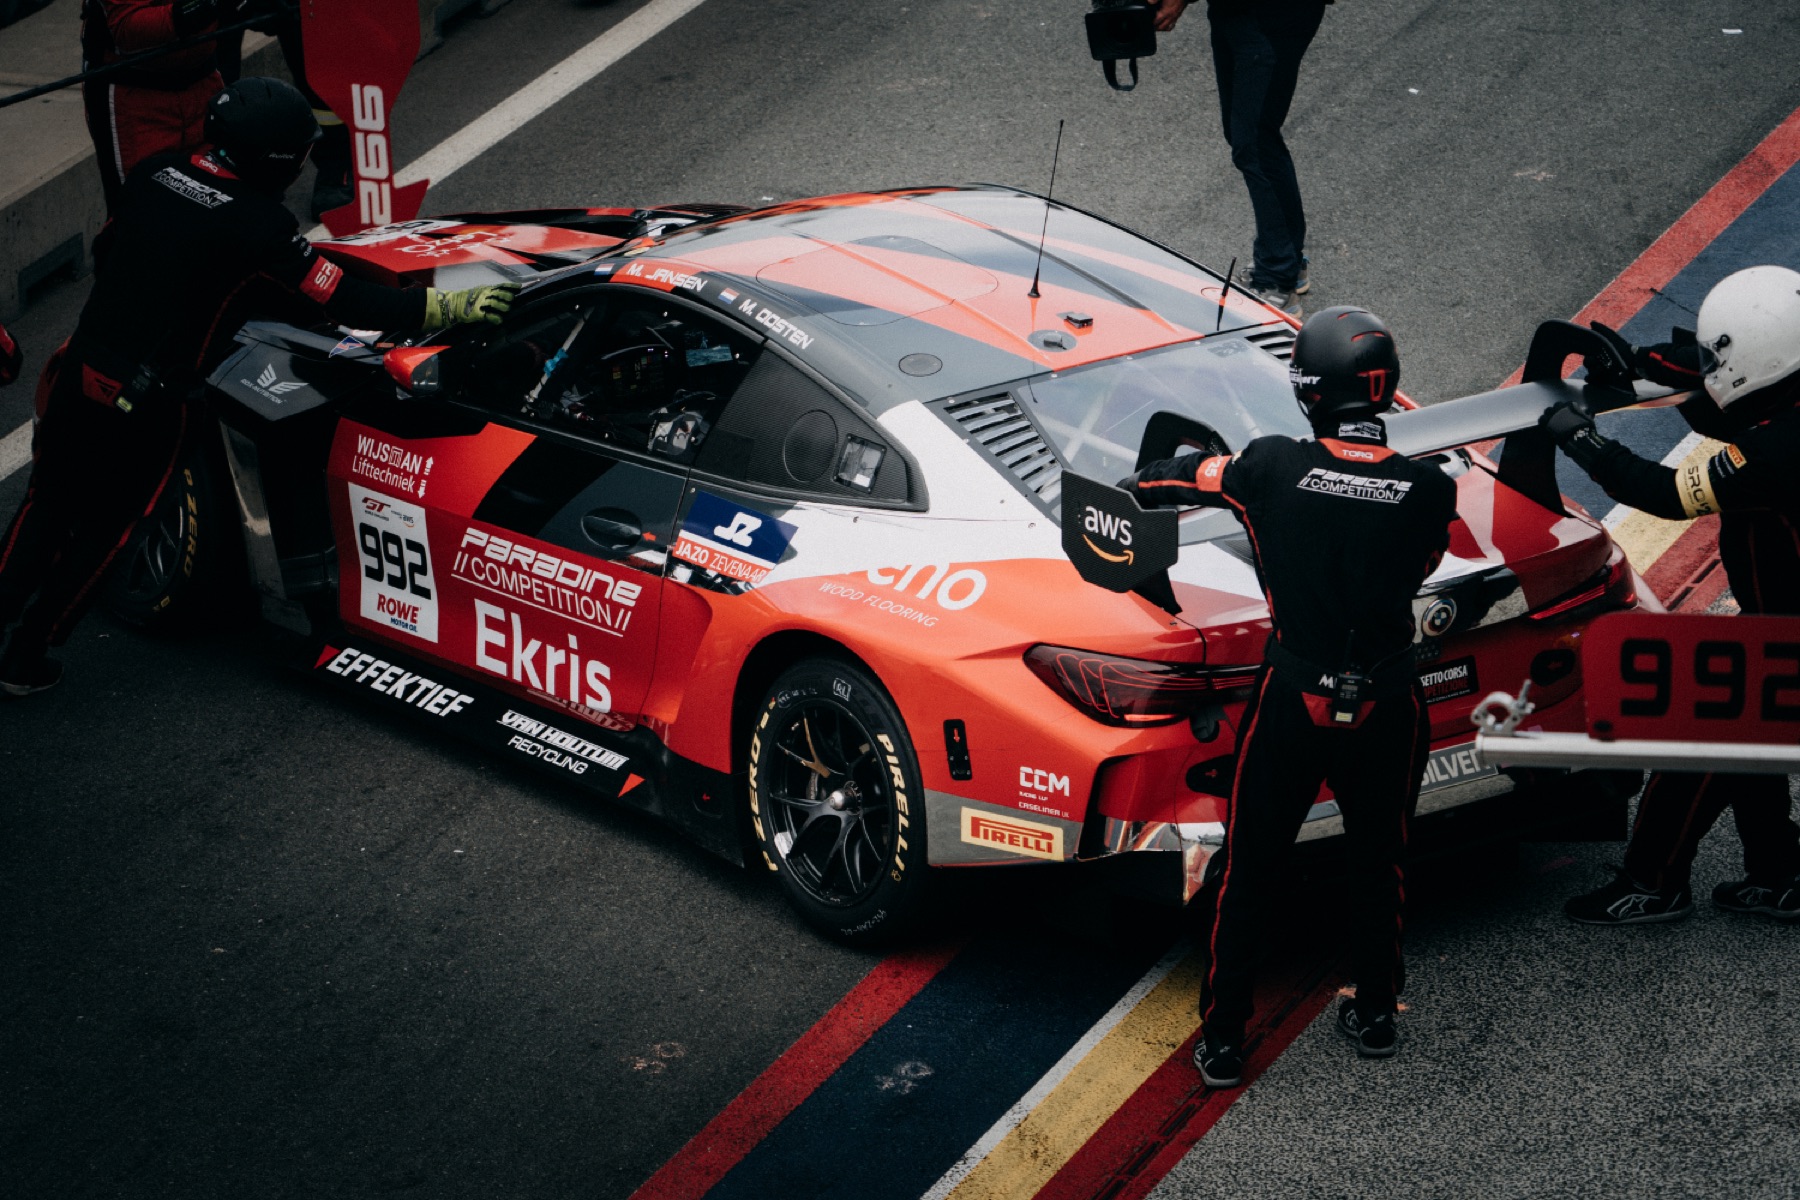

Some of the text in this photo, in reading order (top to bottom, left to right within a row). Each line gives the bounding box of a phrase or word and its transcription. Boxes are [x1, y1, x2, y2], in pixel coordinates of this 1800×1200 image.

[159, 173, 213, 205] COMPETITION
[314, 262, 335, 288] SR
[626, 263, 708, 293] M. JANSEN
[738, 298, 814, 350] M. OOSTEN
[1341, 449, 1374, 461] TORQ
[352, 455, 415, 494] Lifttechniek
[1310, 478, 1395, 500] COMPETITION
[1687, 466, 1706, 503] SRO
[1084, 505, 1133, 546] aws
[359, 522, 432, 600] 992
[675, 540, 767, 583] JAZO ZEVENAAR
[377, 592, 420, 624] ROWE
[471, 556, 612, 627] COMPETITION
[818, 582, 939, 628] WOOD FLOORING
[408, 624, 418, 633] OIL
[473, 598, 612, 714] Ekris
[325, 647, 475, 718] EFFEKTIEF
[1418, 664, 1469, 688] SETTO CORSA
[1621, 638, 1800, 722] 992
[498, 709, 548, 738] VAN
[507, 735, 589, 775] RECYCLING
[1019, 766, 1070, 797] CCM
[749, 732, 767, 842] ZERO
[876, 733, 910, 872] PIRELLI
[970, 816, 1054, 853] PIRELLI
